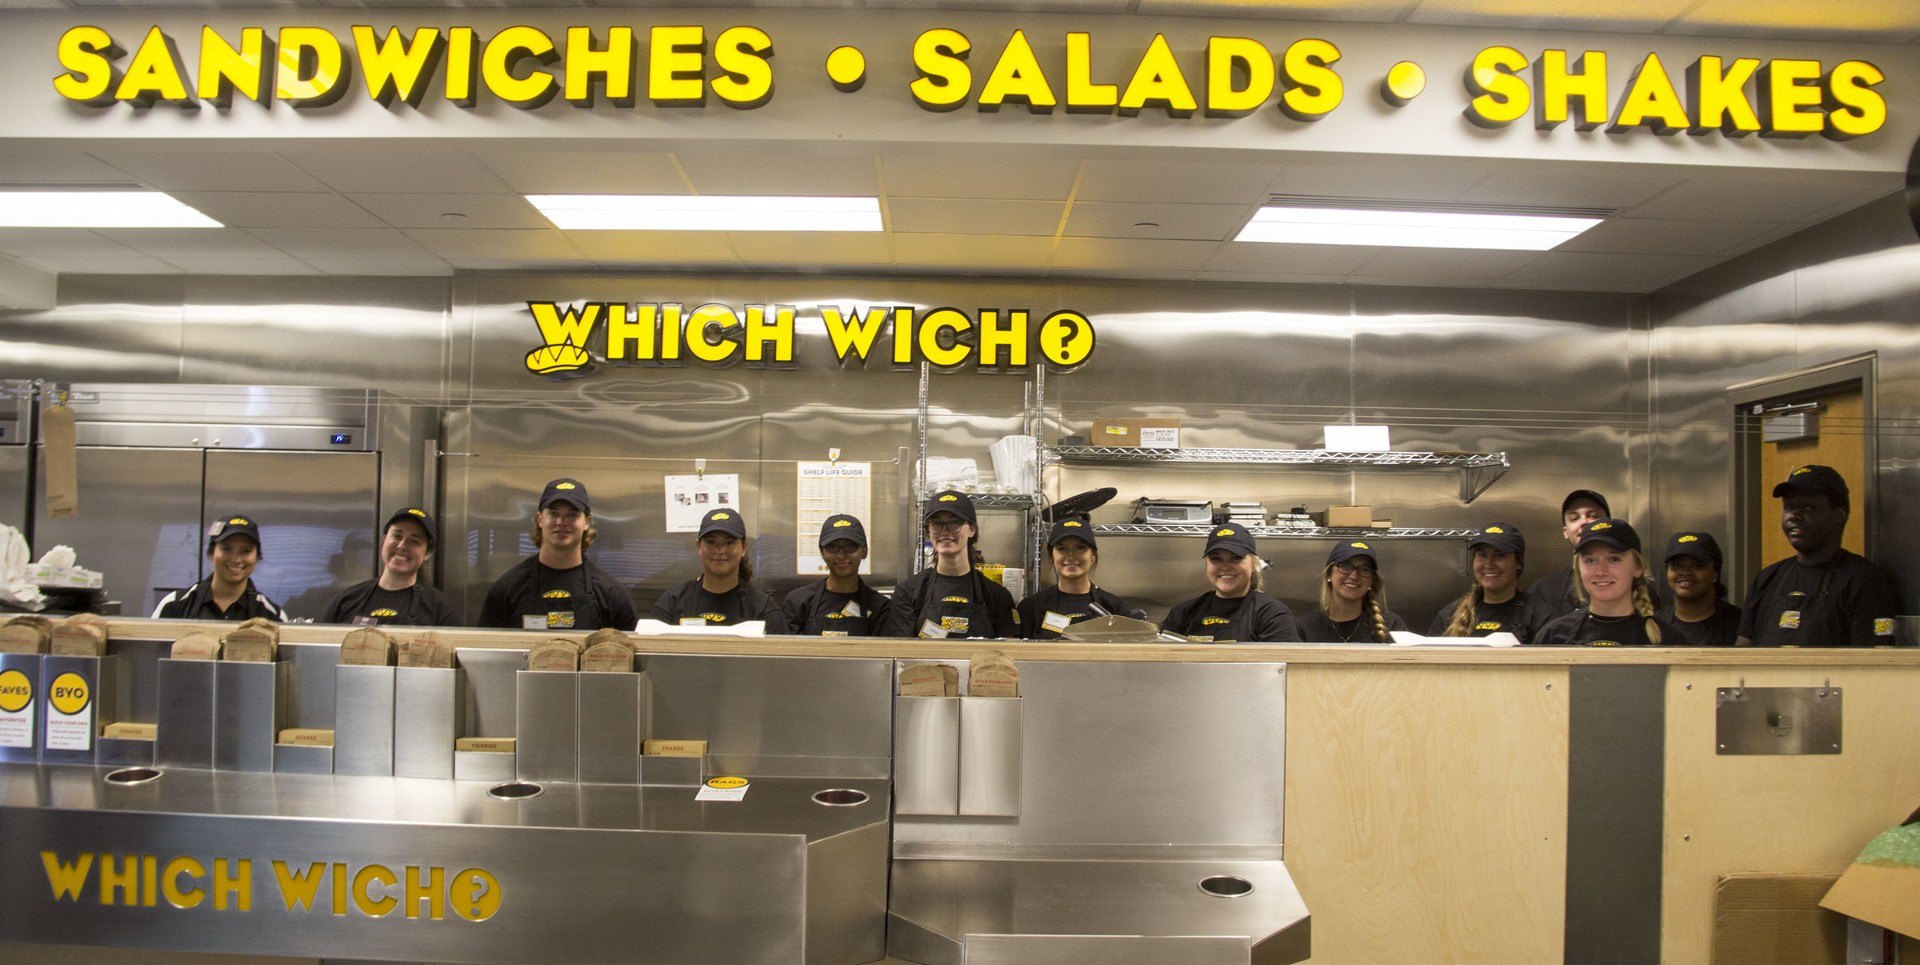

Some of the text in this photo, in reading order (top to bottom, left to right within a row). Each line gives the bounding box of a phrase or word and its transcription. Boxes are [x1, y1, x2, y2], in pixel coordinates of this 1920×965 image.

[53, 24, 1888, 137] SANDWICHES SALADS SHAKES
[525, 301, 797, 373] WHICH
[55, 687, 85, 699] BYO
[40, 851, 253, 912] WHICH
